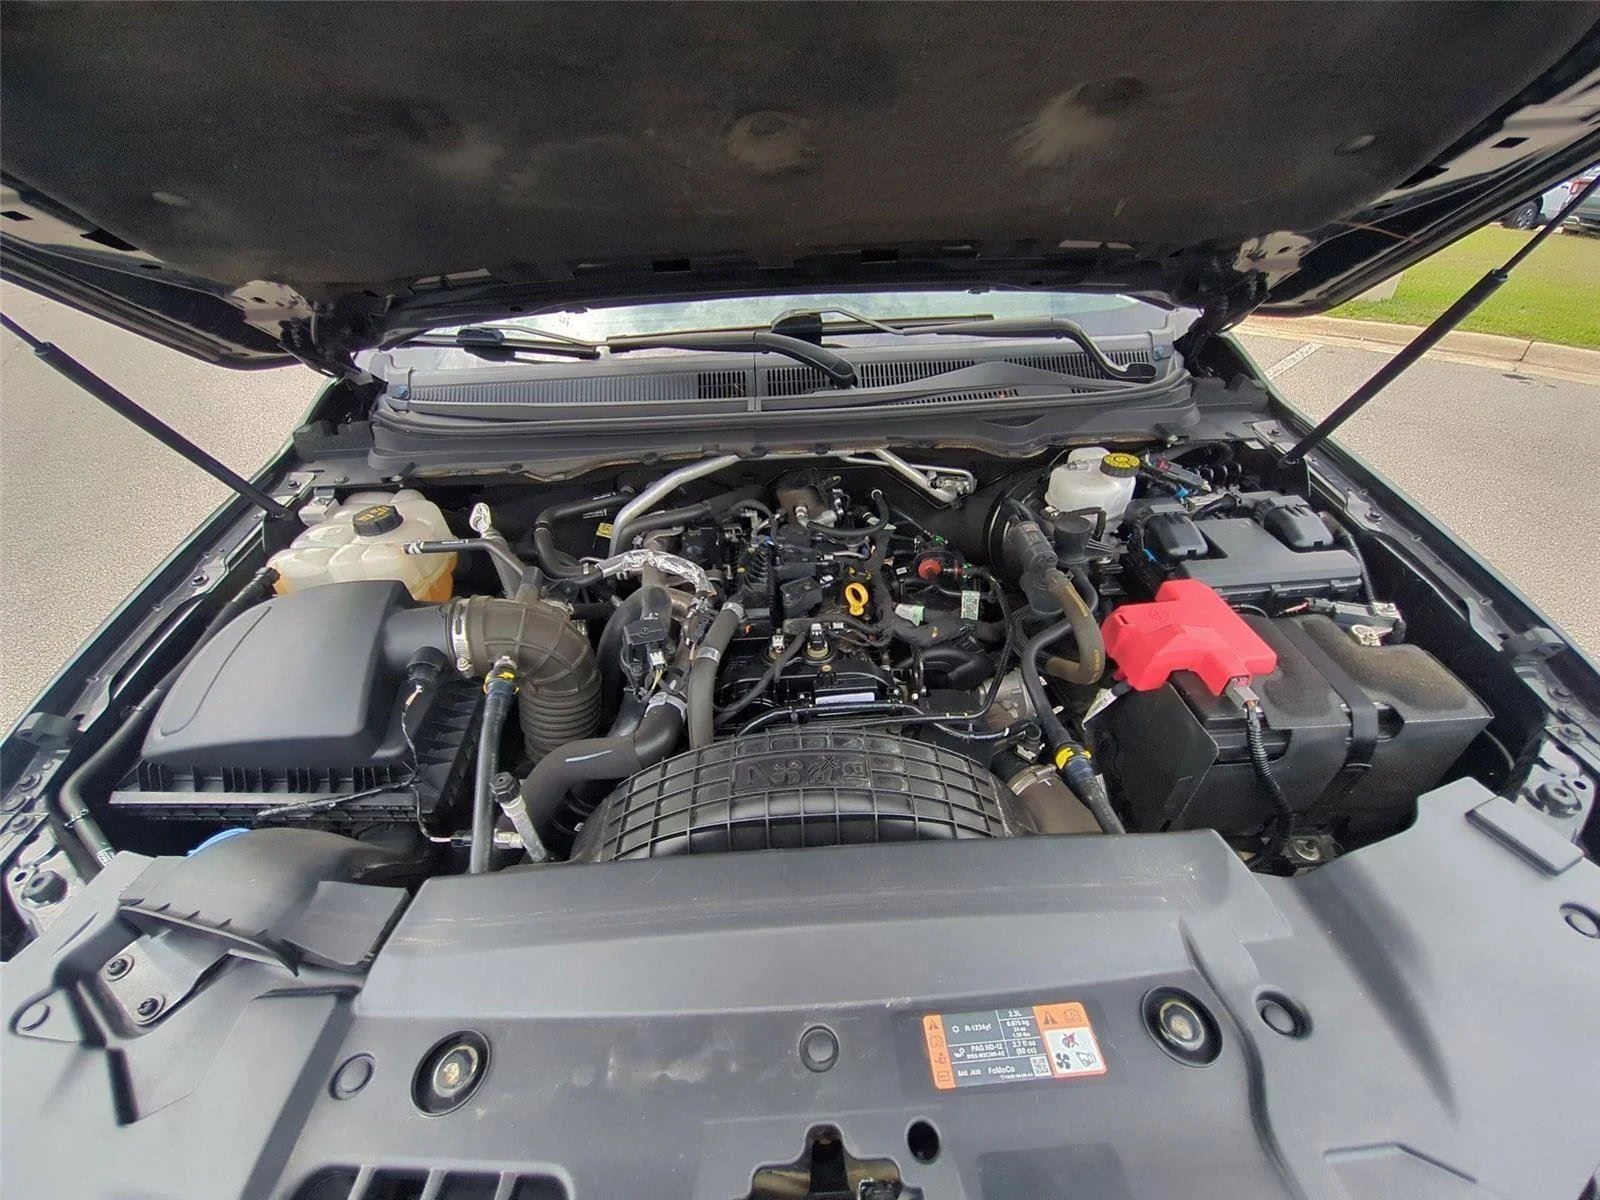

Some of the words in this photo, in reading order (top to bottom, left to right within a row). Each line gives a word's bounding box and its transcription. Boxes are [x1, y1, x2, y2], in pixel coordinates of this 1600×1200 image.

[964, 1022, 992, 1032] R-1234yf
[1021, 1019, 1030, 1027] kg
[971, 1043, 984, 1052] PAG
[985, 1041, 1004, 1051] ND-12
[1026, 1047, 1037, 1055] cc)
[988, 1065, 1016, 1075] FoMoCo
